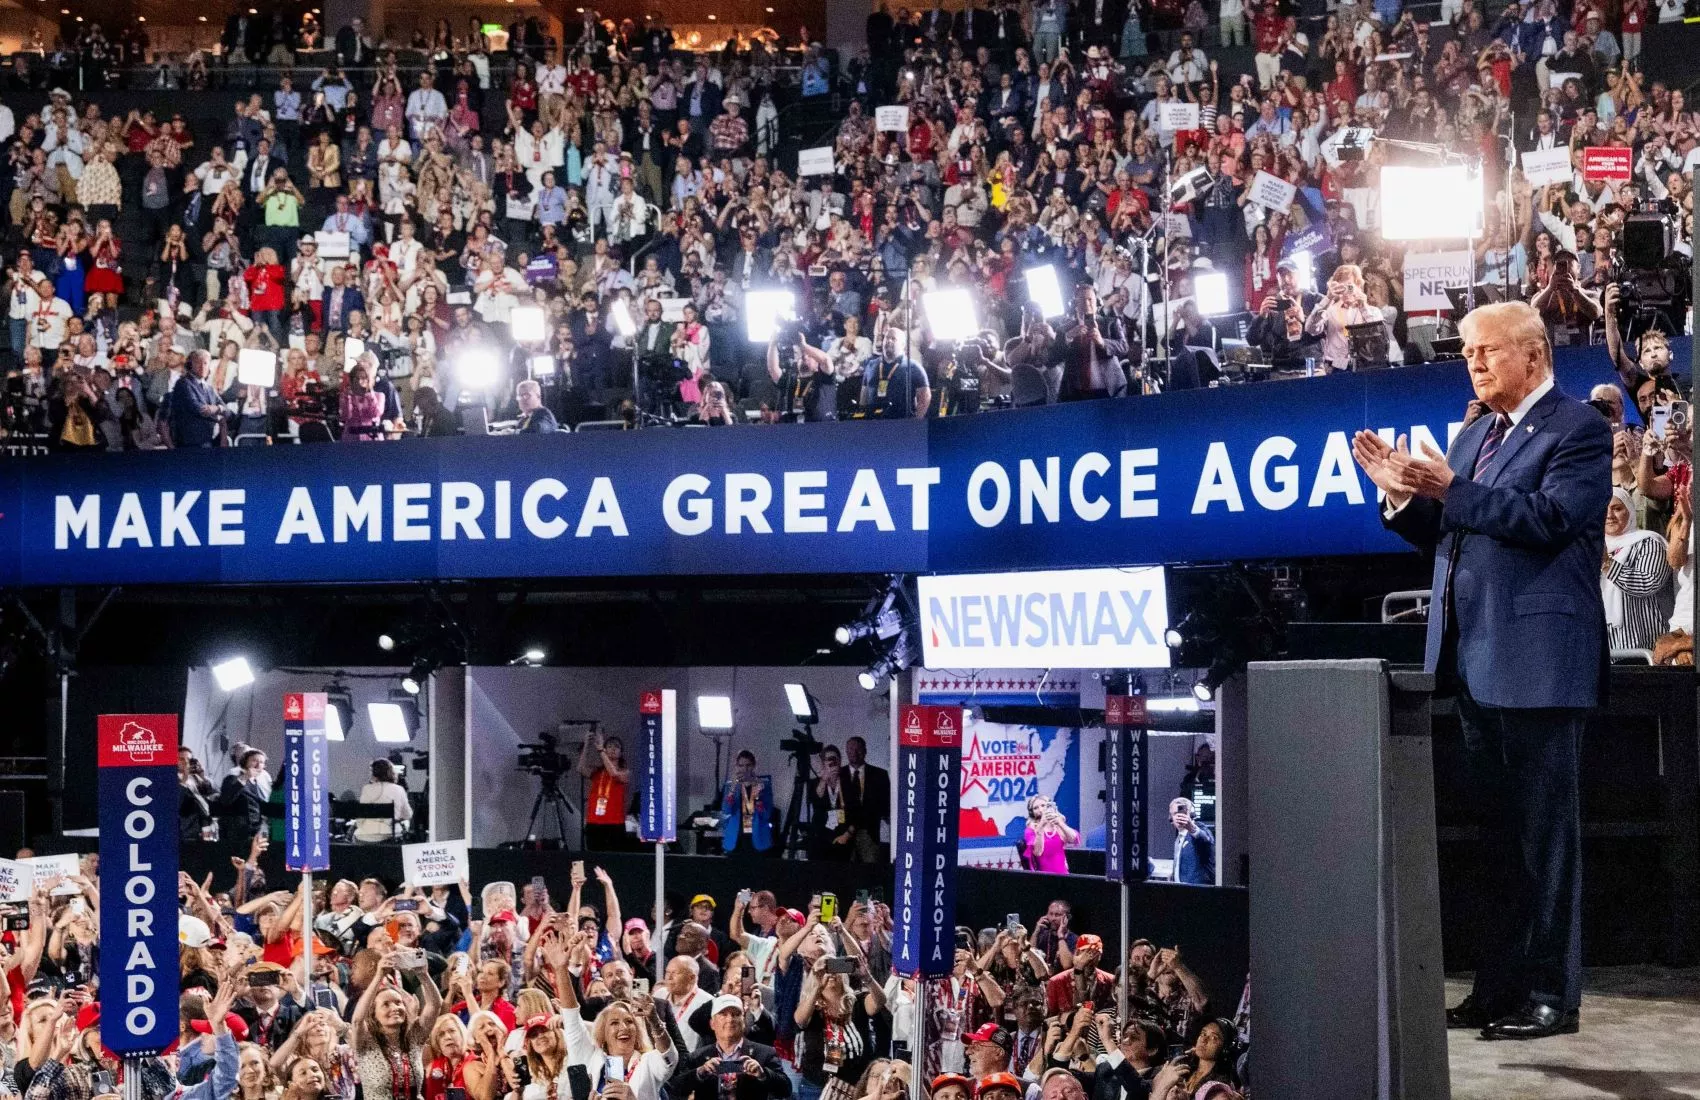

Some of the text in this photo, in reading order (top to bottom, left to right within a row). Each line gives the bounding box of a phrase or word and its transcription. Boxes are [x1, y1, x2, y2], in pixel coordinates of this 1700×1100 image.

[1420, 280, 1469, 296] NE
[56, 490, 245, 549] MAKE
[276, 477, 628, 543] AMERICA
[663, 467, 940, 535] GREAT
[968, 448, 1158, 527] ONCE
[929, 590, 1157, 647] NEWSMAX
[112, 744, 163, 752] MILWAUKEE
[971, 760, 1036, 776] AMERICA
[981, 740, 1017, 754] VOTE
[291, 750, 300, 857] COLUMBIA
[312, 749, 321, 857] COLUMBIA
[988, 776, 1038, 802] 2024
[1110, 730, 1119, 871] WASHINGTON
[1130, 730, 1142, 870] WASHINGTON
[415, 855, 456, 865] AMERICA
[417, 863, 455, 872] STRONG
[422, 848, 448, 857] MAKE
[901, 753, 917, 961] NORTH DAKOTA
[931, 754, 949, 961] NORTH DAKOTA
[125, 778, 156, 1036] COLORADO
